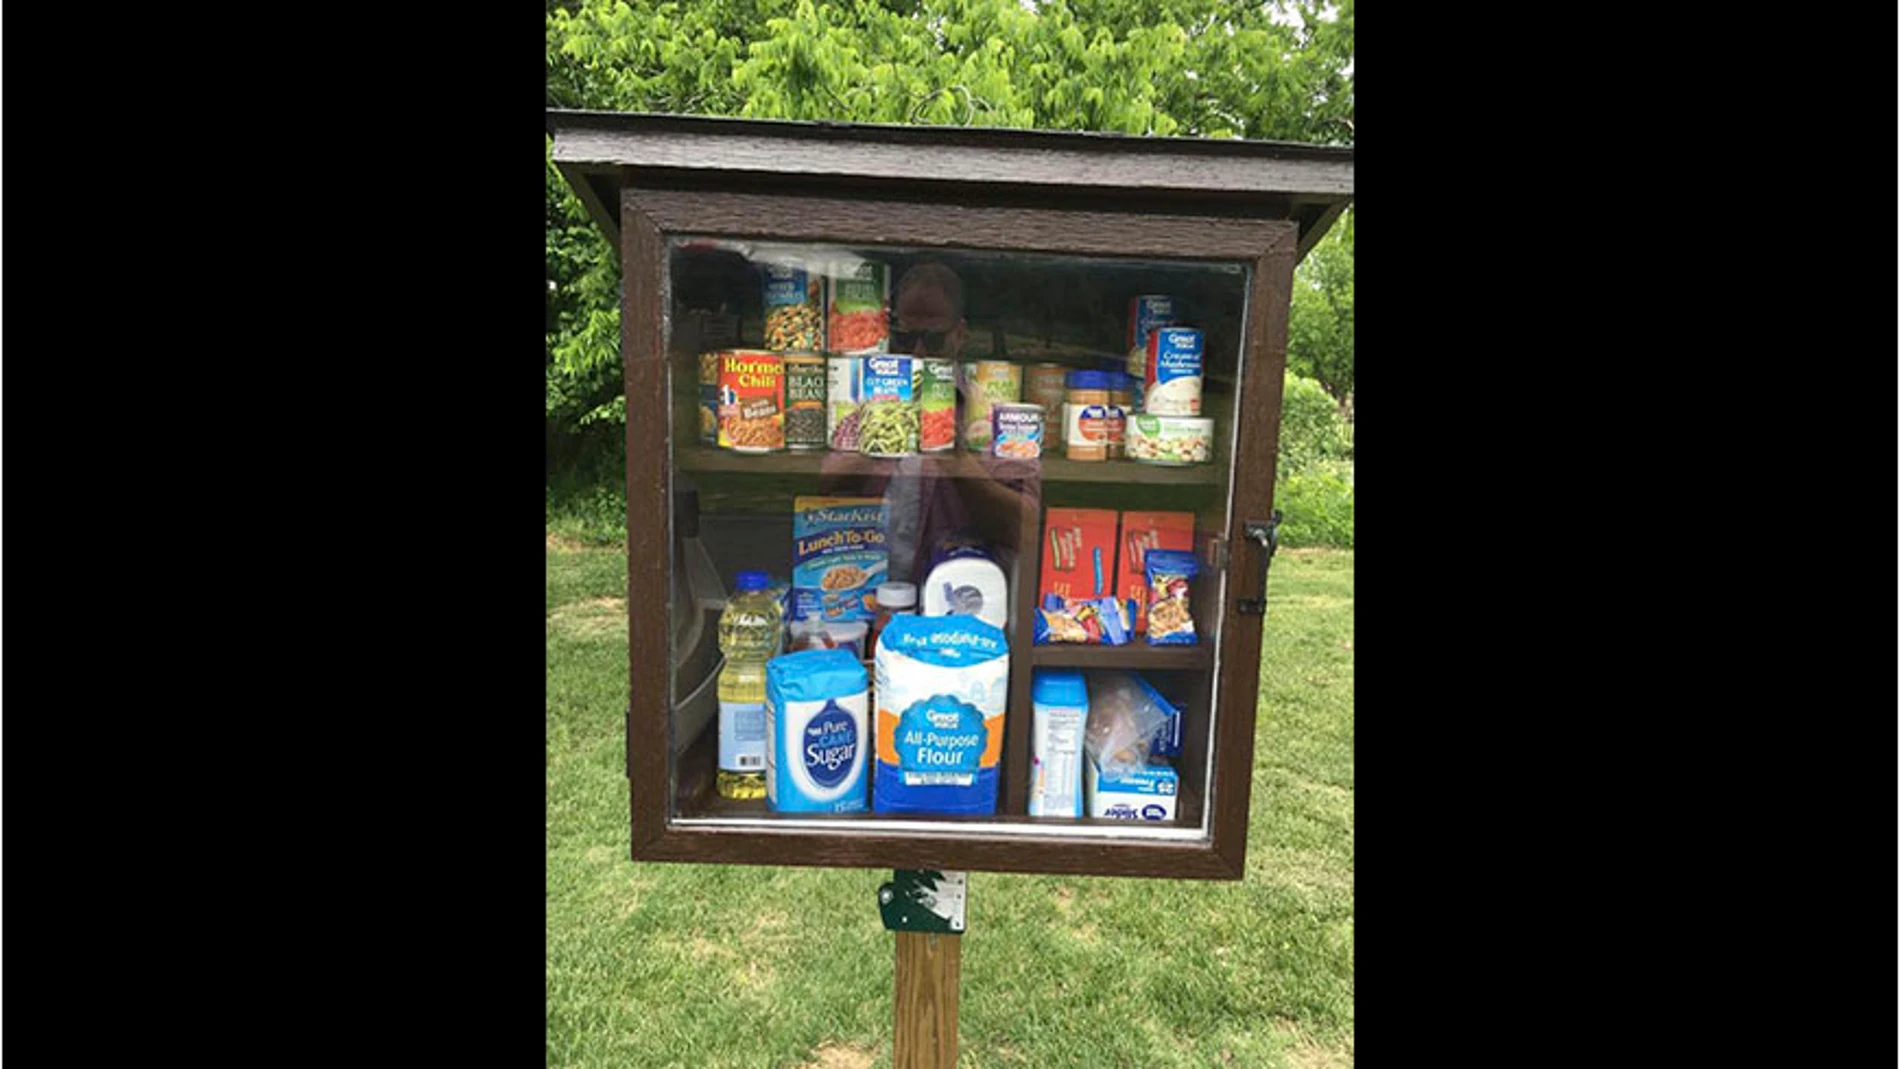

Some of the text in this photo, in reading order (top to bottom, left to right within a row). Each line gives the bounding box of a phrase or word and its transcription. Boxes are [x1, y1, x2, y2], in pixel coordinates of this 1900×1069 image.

[1168, 333, 1195, 345] Great
[738, 373, 776, 388] Chili
[925, 709, 960, 724] Great
[822, 720, 848, 735] Pure
[904, 729, 979, 750] All-Purpose
[807, 743, 855, 770] Sugar
[917, 747, 964, 766] Flour
